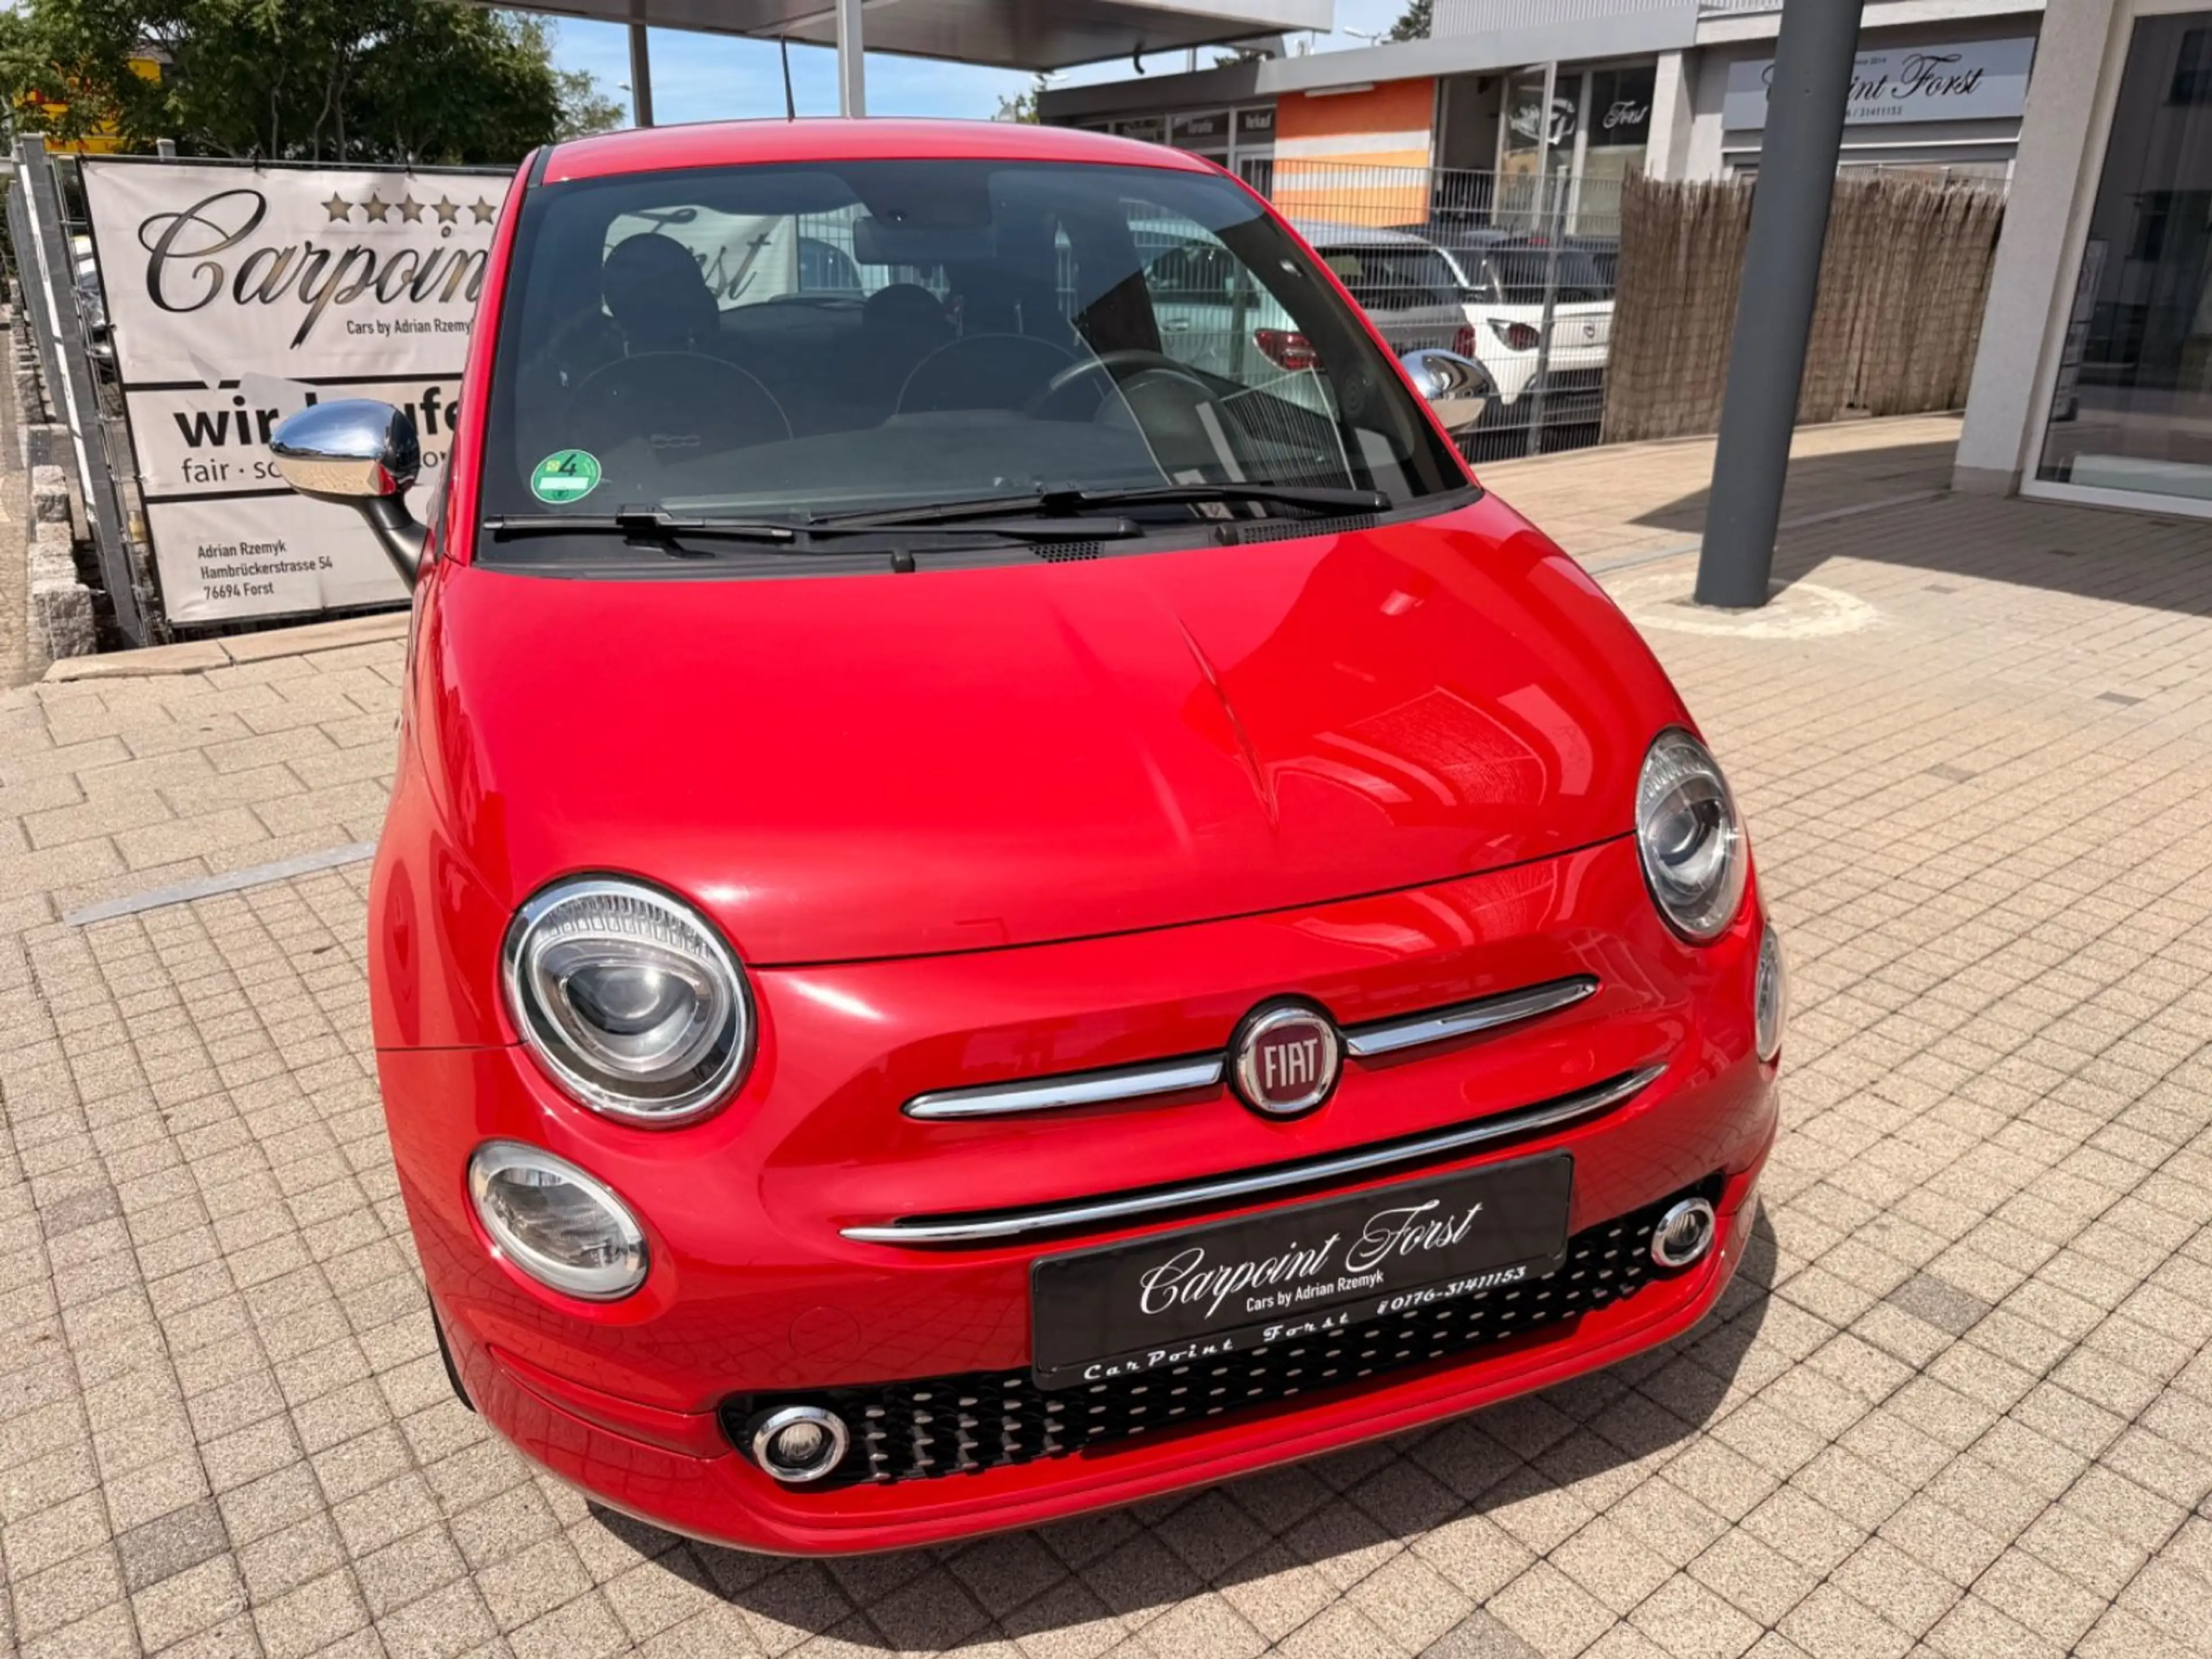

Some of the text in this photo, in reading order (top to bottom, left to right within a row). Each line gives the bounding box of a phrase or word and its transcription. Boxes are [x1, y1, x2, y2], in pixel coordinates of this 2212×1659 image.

[1891, 53, 1984, 99] Forst
[138, 188, 488, 350] Carpoin
[347, 318, 472, 338] Cars by Adrian Rzemy
[173, 395, 279, 448] wir
[181, 458, 229, 483] fair
[558, 453, 577, 476] 4
[198, 539, 287, 559] Adrian Rzemyk
[200, 555, 333, 579] Hambrückerstrasse 54
[203, 581, 274, 600] 76694 Forst
[1264, 1038, 1318, 1089] FIAT
[1140, 1199, 1483, 1320] Carpoint Forst
[1246, 1269, 1384, 1312] Cars by Adrian Rzemyk
[1262, 1311, 1350, 1343] Forst
[1390, 1266, 1527, 1311] 0176-31411153
